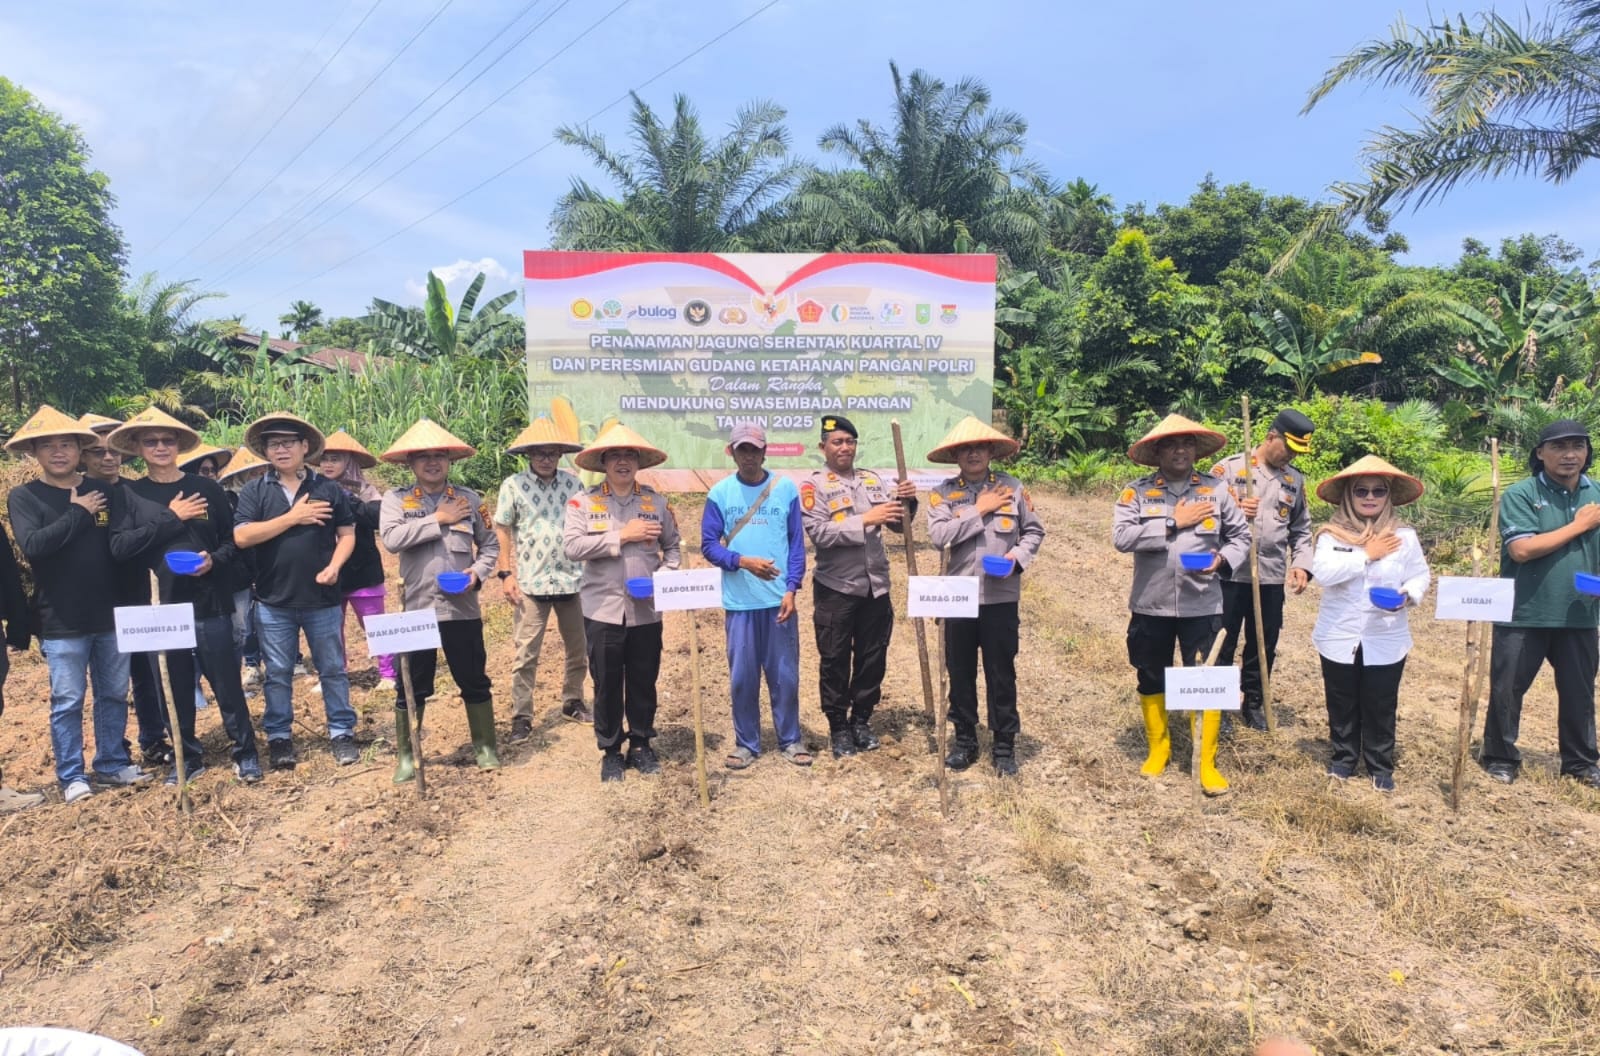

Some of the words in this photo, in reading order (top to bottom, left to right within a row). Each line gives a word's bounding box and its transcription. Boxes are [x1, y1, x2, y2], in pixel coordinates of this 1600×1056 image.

[638, 305, 677, 319] bulog
[590, 335, 693, 349] PENANAMAN
[696, 335, 760, 349] JAGUNG
[763, 335, 847, 349] SERENTAK
[850, 335, 922, 349] KUARTAL
[925, 336, 942, 349] IV
[552, 358, 586, 371] DAN
[590, 358, 685, 372] PERESMIAN
[689, 358, 756, 372] GUDANG
[761, 359, 854, 372] KETAHANAN
[859, 359, 923, 372] PANGAN
[928, 359, 975, 372] POLRI
[709, 376, 761, 391] Dalam
[767, 376, 824, 394] Rangka
[621, 396, 725, 409] MENDUKUNG
[729, 396, 843, 410] SWASEMBADA
[847, 396, 911, 410] PANGAN
[772, 415, 813, 428] 2025
